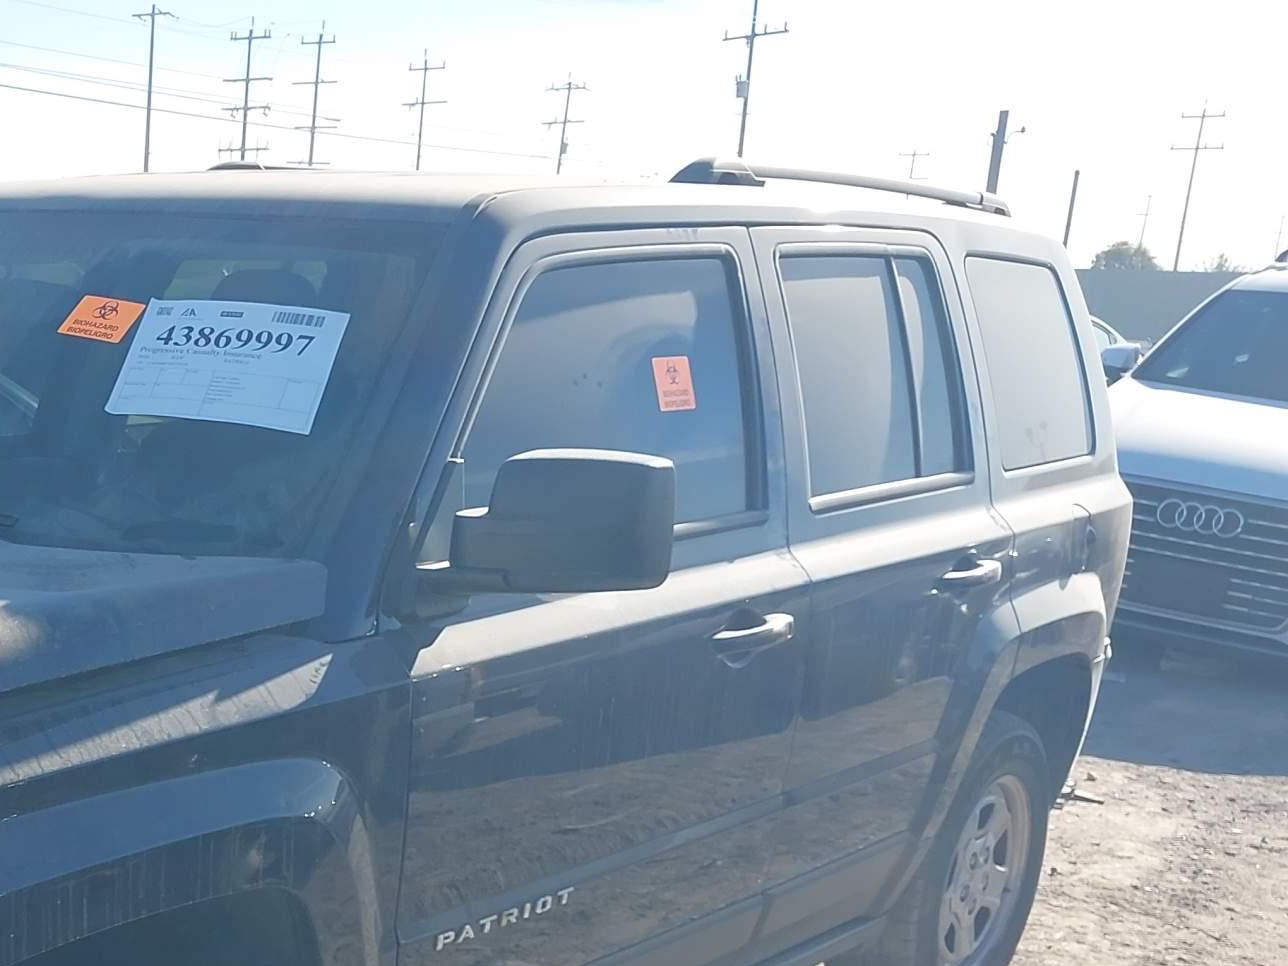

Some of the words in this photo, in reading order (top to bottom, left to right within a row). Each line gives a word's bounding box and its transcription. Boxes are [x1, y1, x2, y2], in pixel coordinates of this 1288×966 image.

[66, 326, 114, 339] BIOPELIGRO
[72, 319, 119, 332] BIOHAZARD
[156, 324, 316, 357] 43869997
[435, 886, 575, 951] PATRIOT
